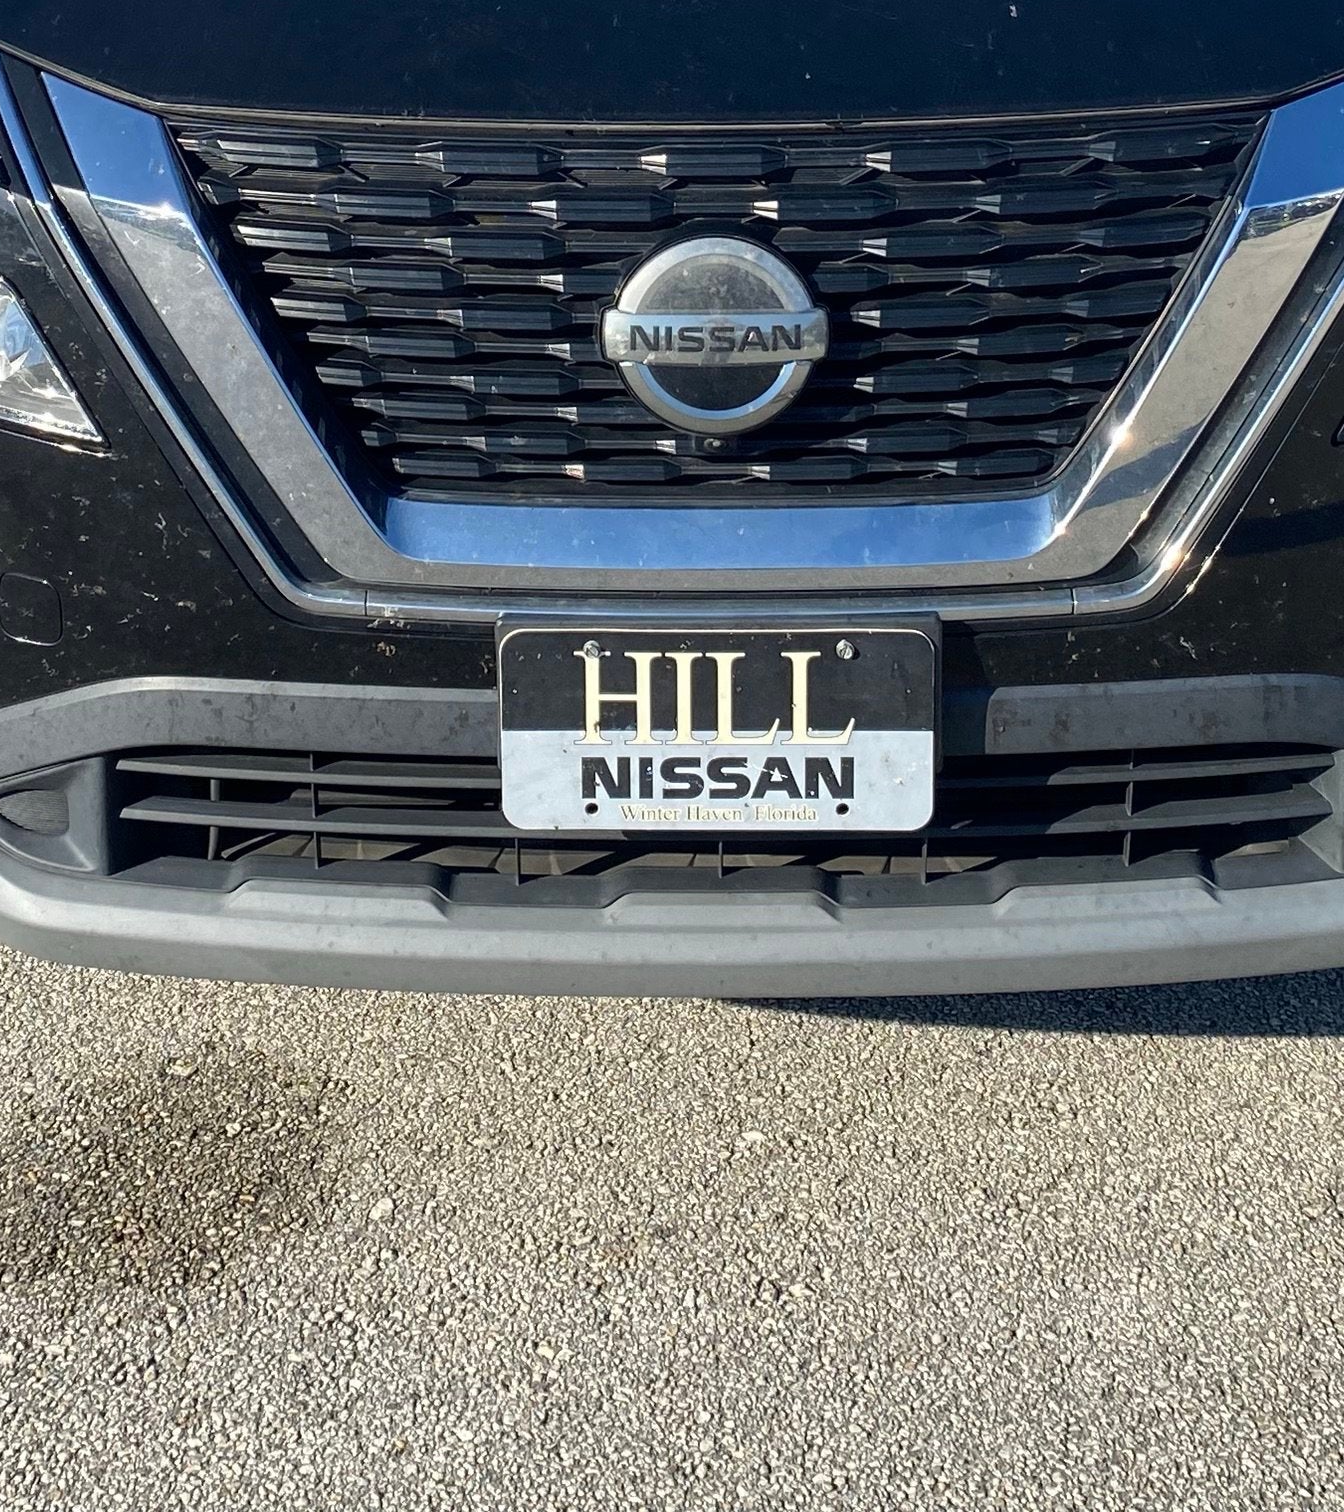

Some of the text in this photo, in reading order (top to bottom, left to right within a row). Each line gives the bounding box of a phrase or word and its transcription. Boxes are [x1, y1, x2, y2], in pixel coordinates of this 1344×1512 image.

[629, 324, 802, 353] NISSAN
[573, 649, 856, 746] HILL
[580, 755, 856, 801] NISSAN
[620, 802, 819, 822] Winter Haven Florida
